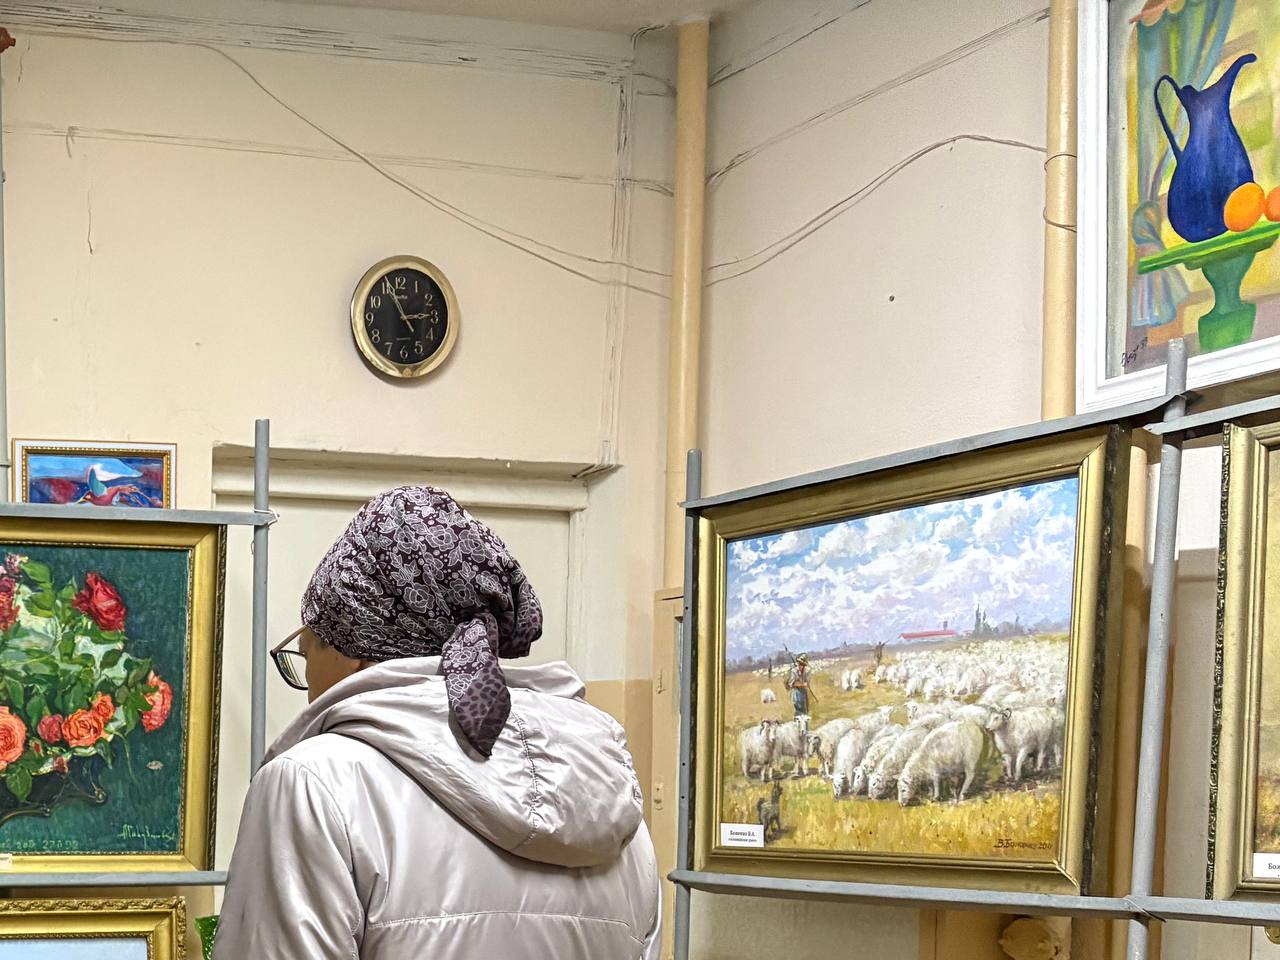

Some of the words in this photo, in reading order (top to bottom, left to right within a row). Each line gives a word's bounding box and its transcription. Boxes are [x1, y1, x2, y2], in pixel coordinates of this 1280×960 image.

[395, 276, 406, 290] 12
[370, 295, 381, 309] 10
[425, 293, 433, 306] 2
[365, 312, 374, 326] 9
[430, 310, 439, 324] 3
[371, 329, 380, 343] 8
[425, 328, 434, 341] 4
[384, 342, 393, 355] 7
[400, 346, 408, 359] 6
[414, 341, 423, 354] 5
